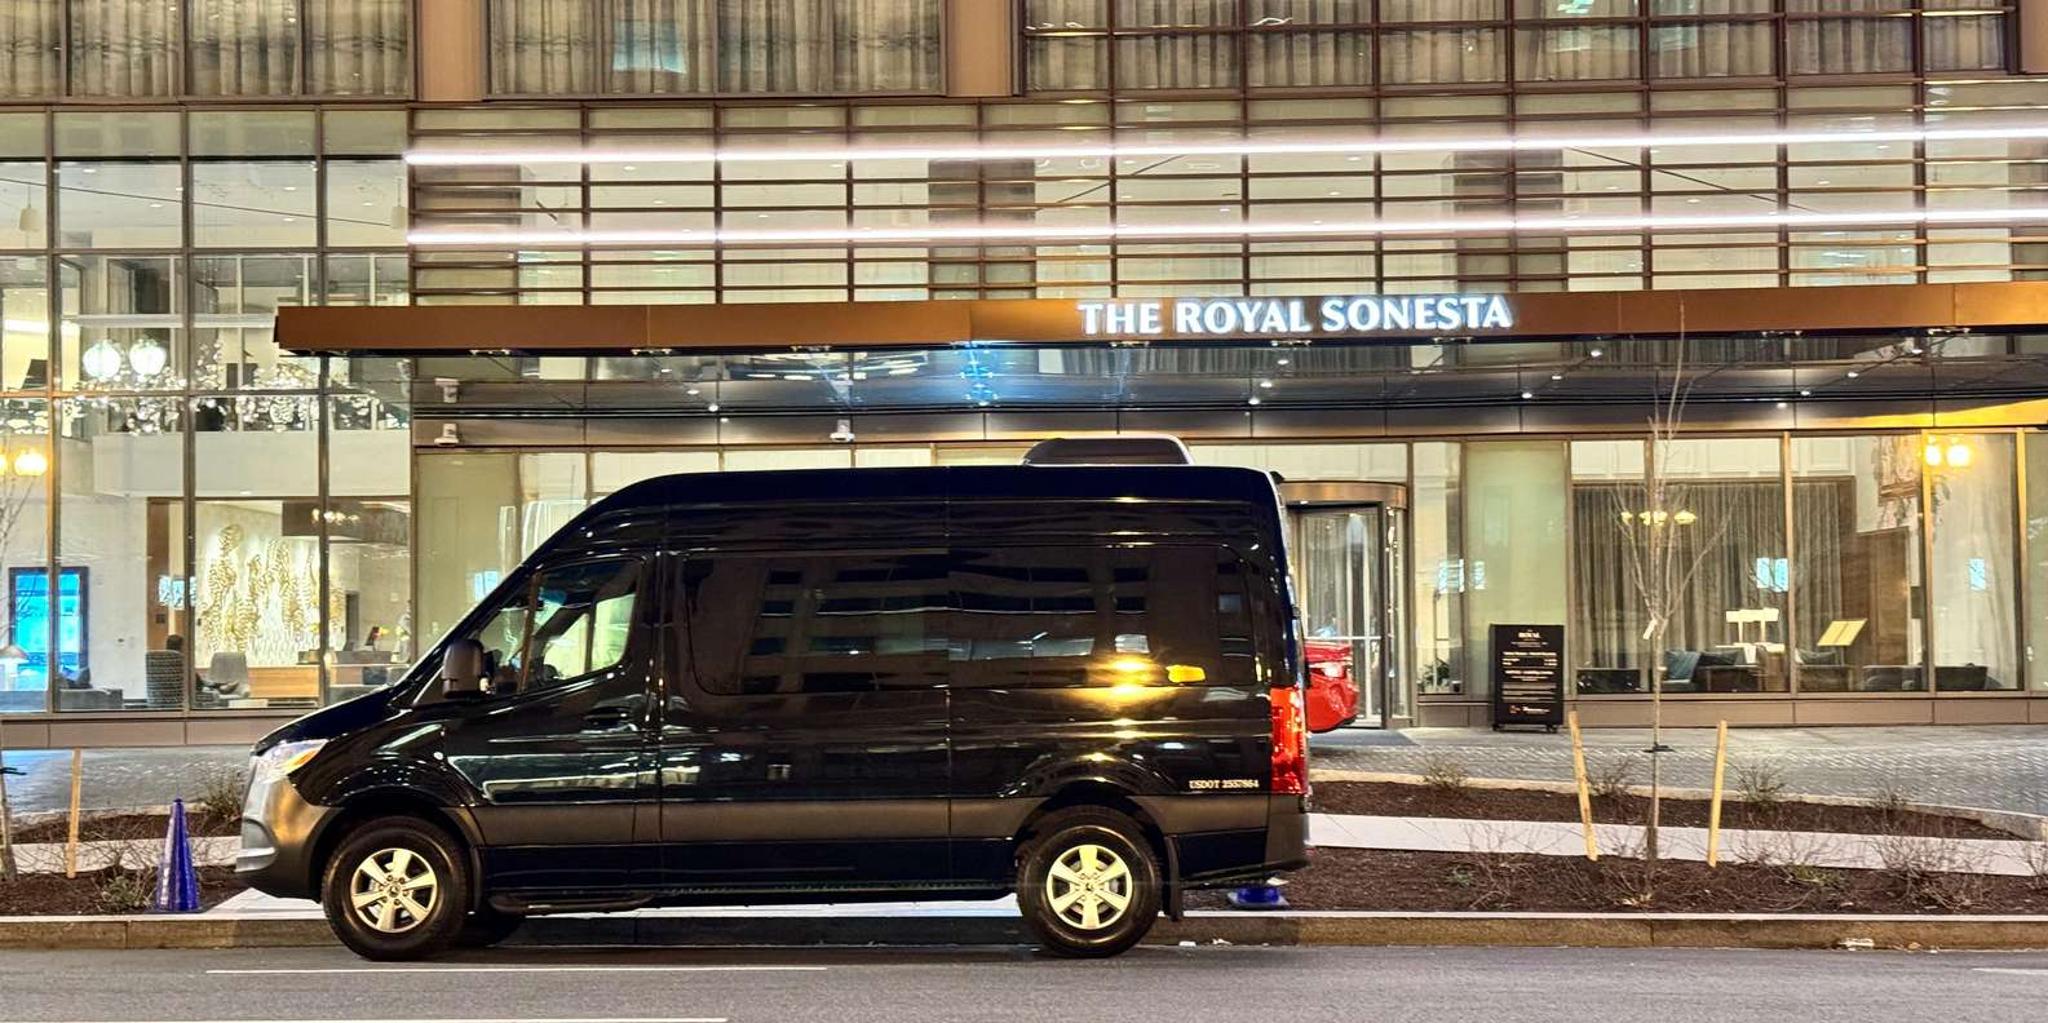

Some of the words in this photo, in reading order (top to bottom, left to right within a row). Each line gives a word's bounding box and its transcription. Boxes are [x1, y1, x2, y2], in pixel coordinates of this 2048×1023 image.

[1078, 302, 1162, 335] THE
[1174, 298, 1313, 334] ROYAL
[1321, 295, 1513, 332] SONESTA
[1188, 779, 1220, 789] USDOT
